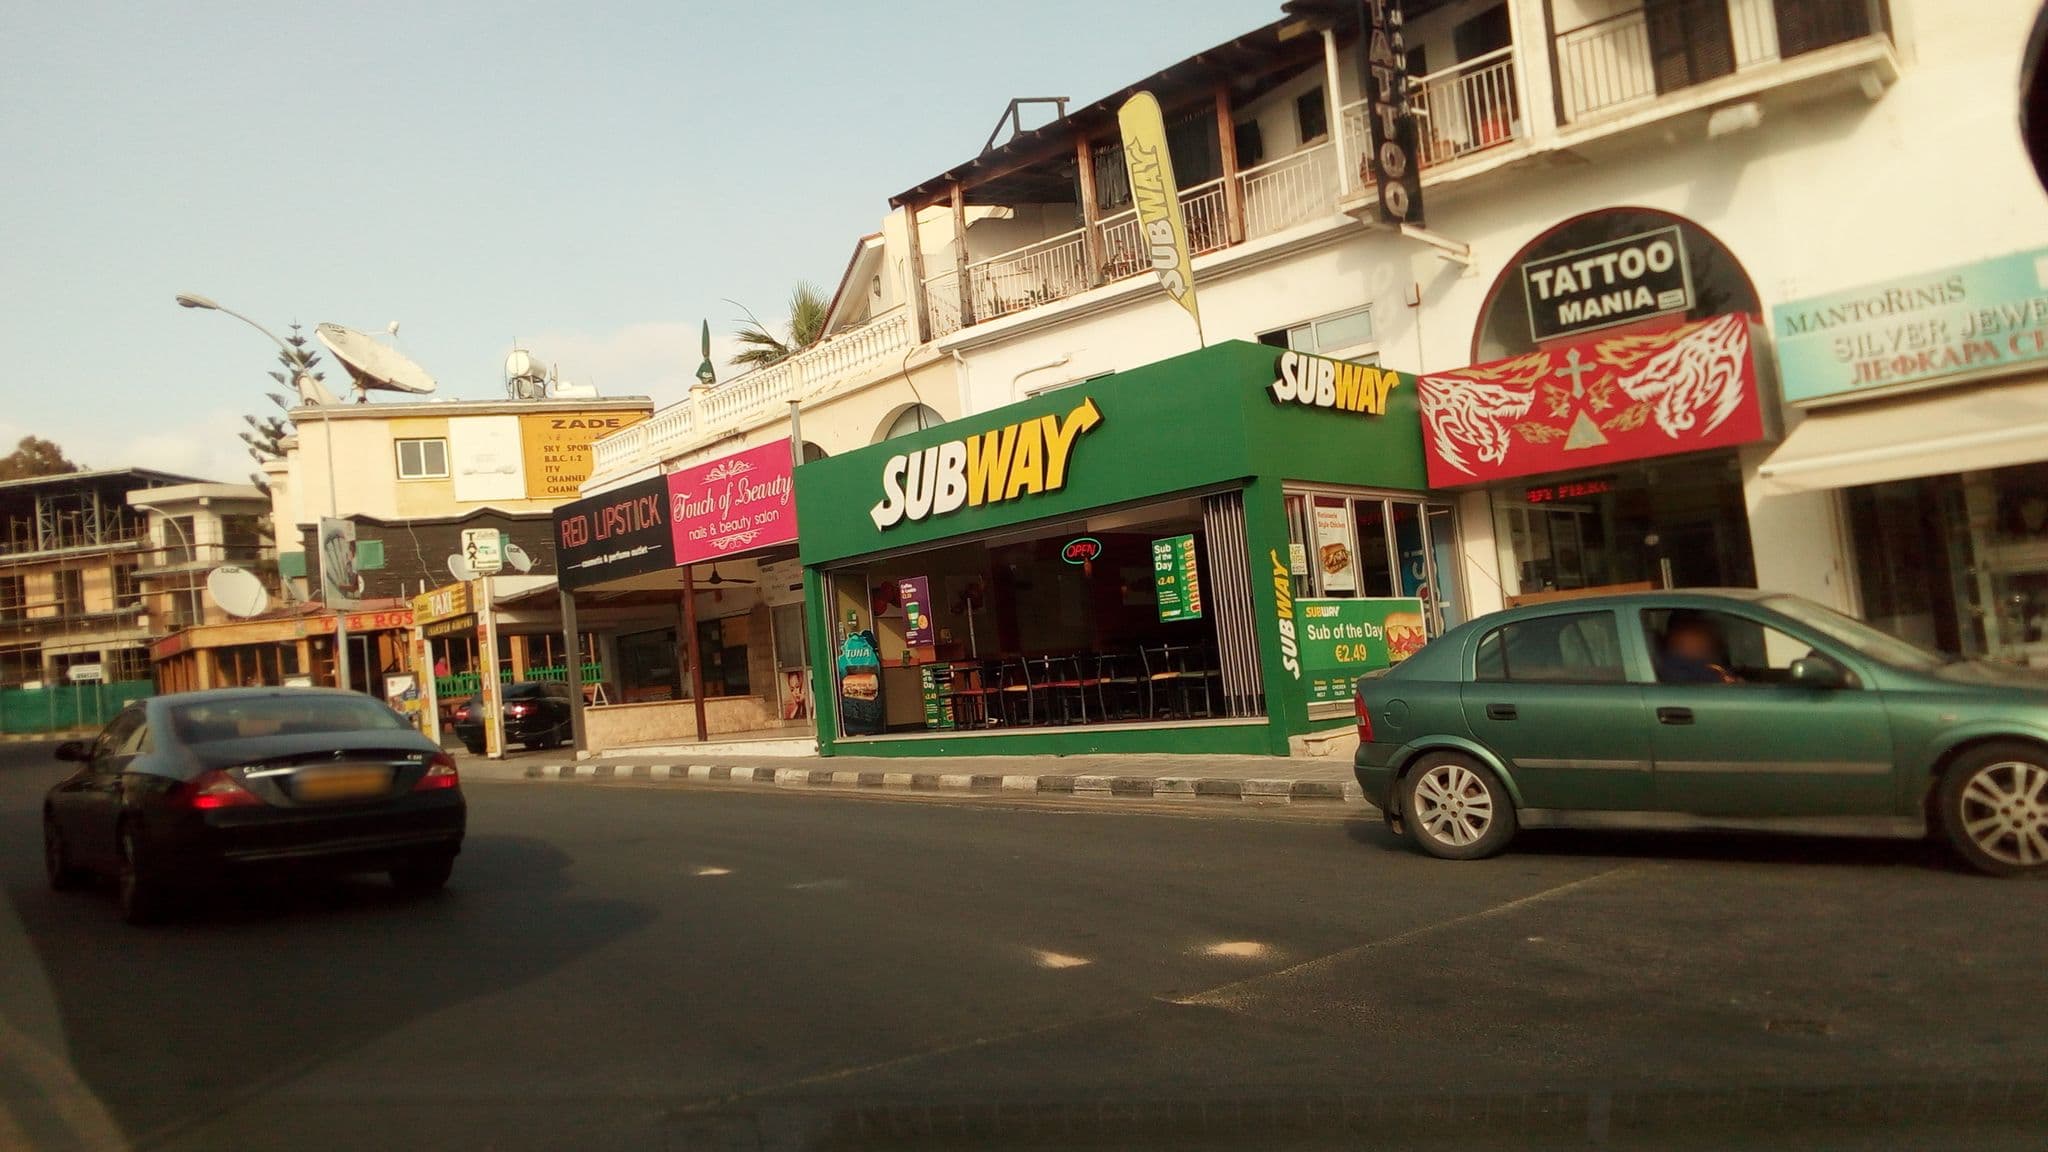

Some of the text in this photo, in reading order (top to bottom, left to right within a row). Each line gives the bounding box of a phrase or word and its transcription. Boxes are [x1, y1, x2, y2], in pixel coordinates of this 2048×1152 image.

[1369, 0, 1409, 219] TATTOO
[1126, 136, 1190, 301] SUBWAY
[1530, 240, 1675, 300] TATTOO
[1558, 285, 1655, 326] MANIA
[1834, 318, 1950, 362] SILVER
[1852, 339, 2000, 386] ЛЕФКАРА
[1271, 350, 1400, 416] SUBWAY
[551, 418, 621, 430] ZADE
[543, 445, 560, 453] SKY
[870, 397, 1104, 532] SUBWAY
[673, 475, 794, 523] Touch of Beauty
[561, 493, 662, 550] RED LIPSTICK
[688, 509, 780, 541] nails & beauty salon
[465, 531, 478, 569] TAXI
[1066, 543, 1096, 558] OPEN
[1153, 544, 1171, 554] Sub
[1155, 562, 1173, 571] Day
[428, 590, 453, 617] TAXI
[1270, 549, 1300, 680] SUBWAY
[1306, 606, 1340, 618] SUBWAY
[320, 617, 361, 632] TE
[1307, 623, 1383, 640] Sub of the Day
[847, 648, 870, 658] TUNA
[1335, 644, 1367, 662] €2.49
